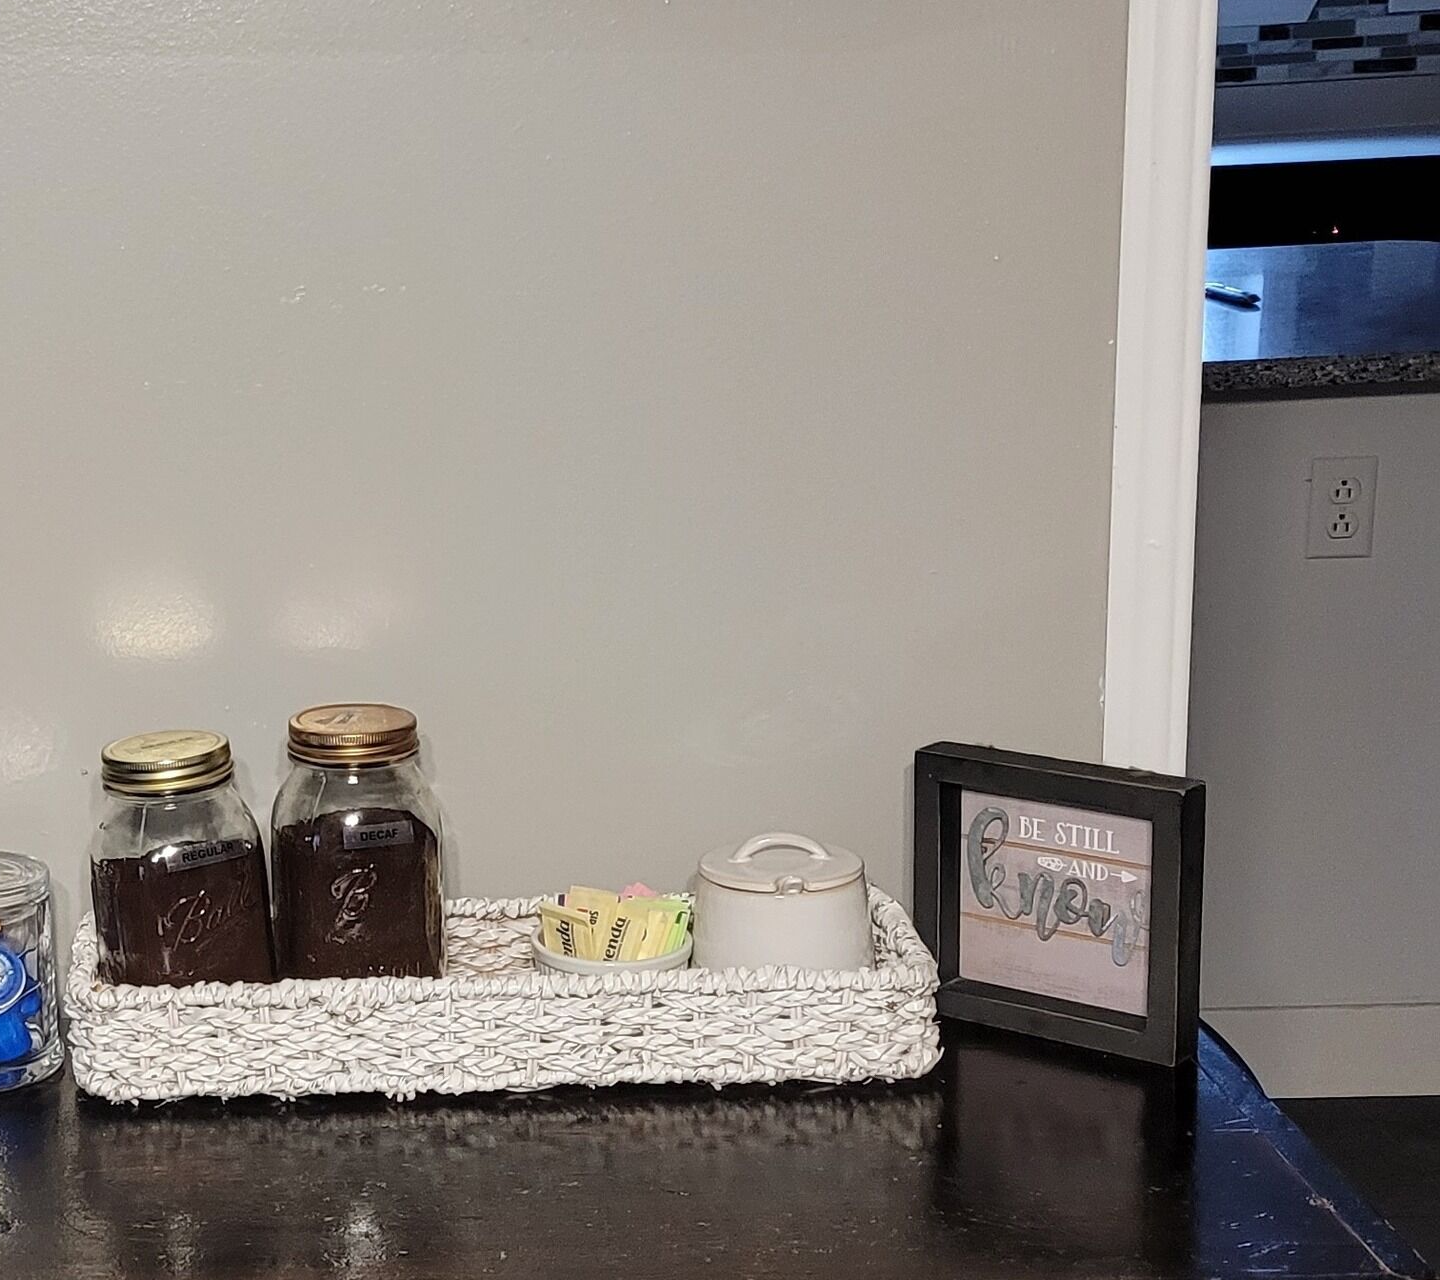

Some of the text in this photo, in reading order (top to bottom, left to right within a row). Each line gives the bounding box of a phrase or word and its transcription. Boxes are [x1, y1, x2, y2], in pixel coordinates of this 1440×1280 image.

[360, 828, 399, 842] DECAF
[1018, 815, 1119, 854] BE STILL
[181, 842, 234, 864] REGULAR
[1065, 858, 1109, 882] AND
